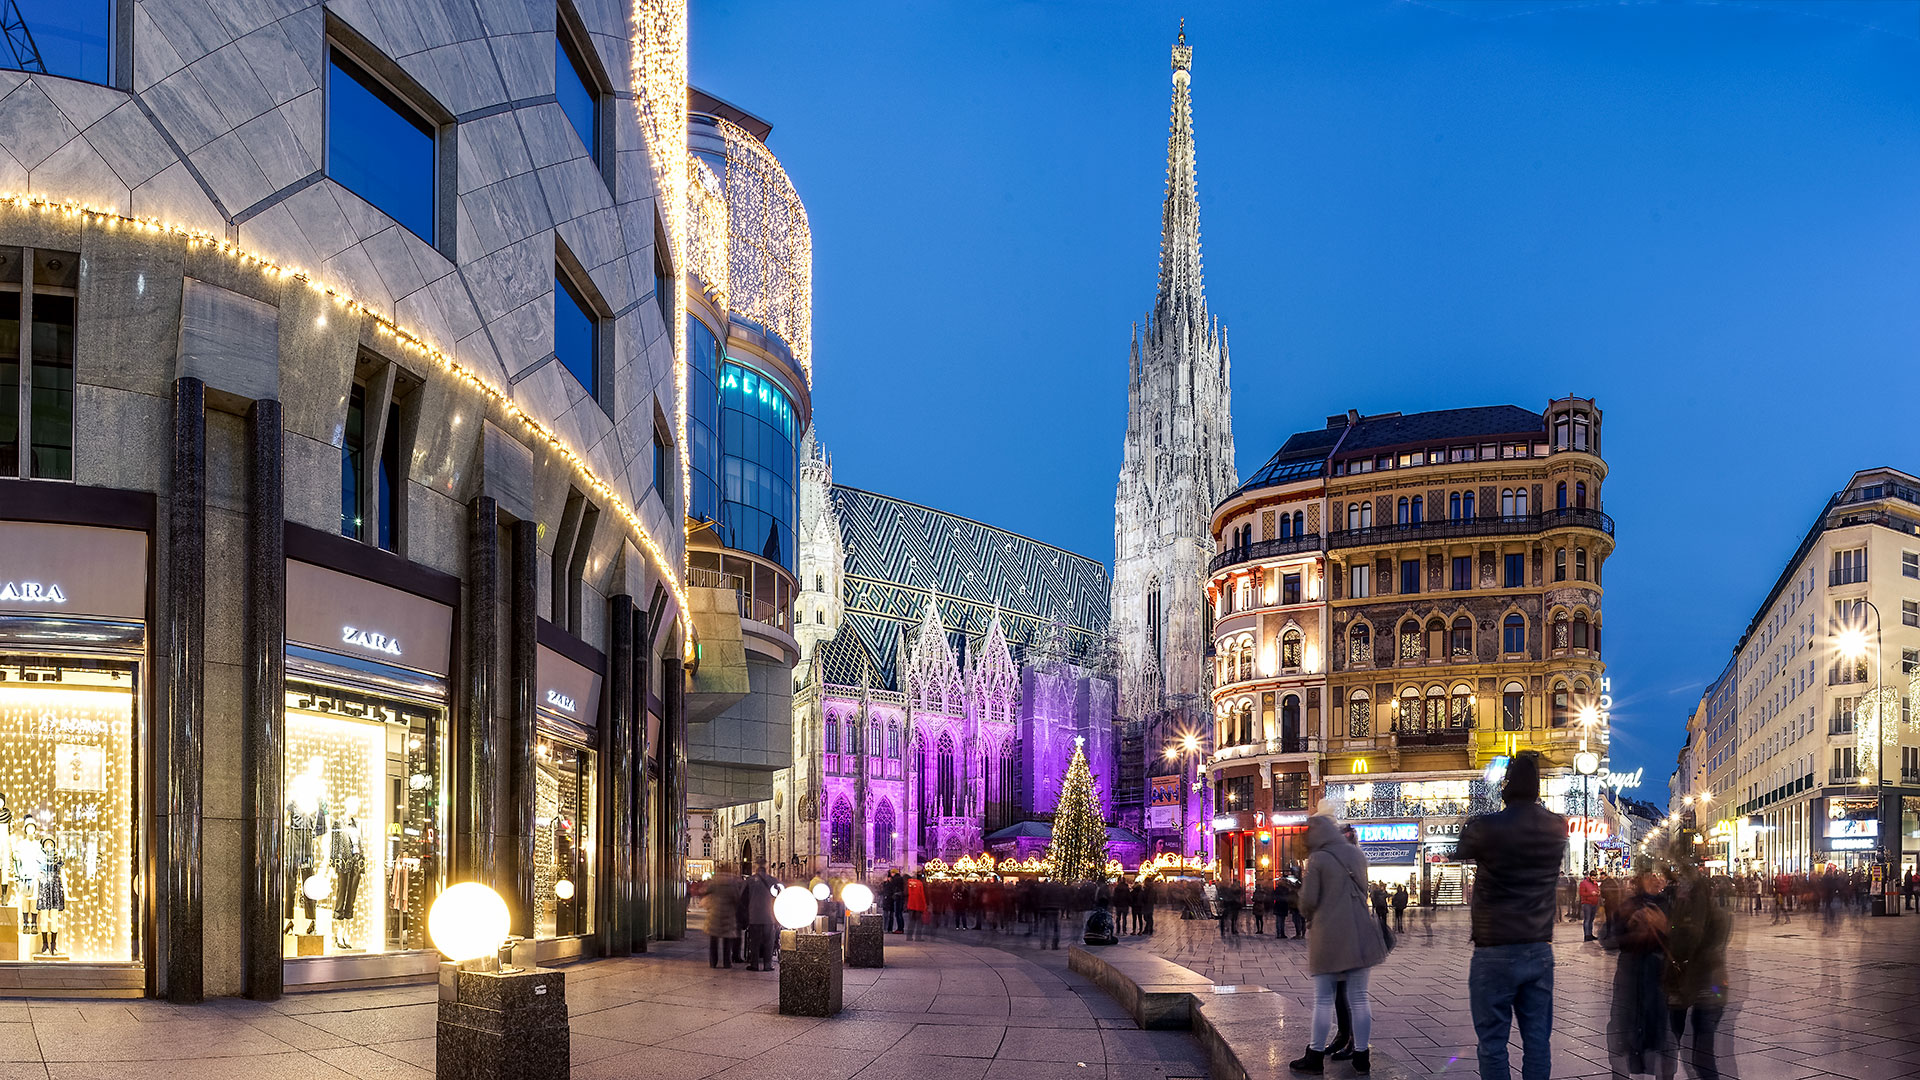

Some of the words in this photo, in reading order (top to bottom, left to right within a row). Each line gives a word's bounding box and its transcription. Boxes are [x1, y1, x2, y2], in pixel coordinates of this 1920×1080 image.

[0, 582, 66, 602] ARA
[342, 626, 402, 655] ZARA
[547, 690, 577, 712] ZARA
[1595, 767, 1643, 801] Royal
[1365, 826, 1419, 841] EXCHANGE
